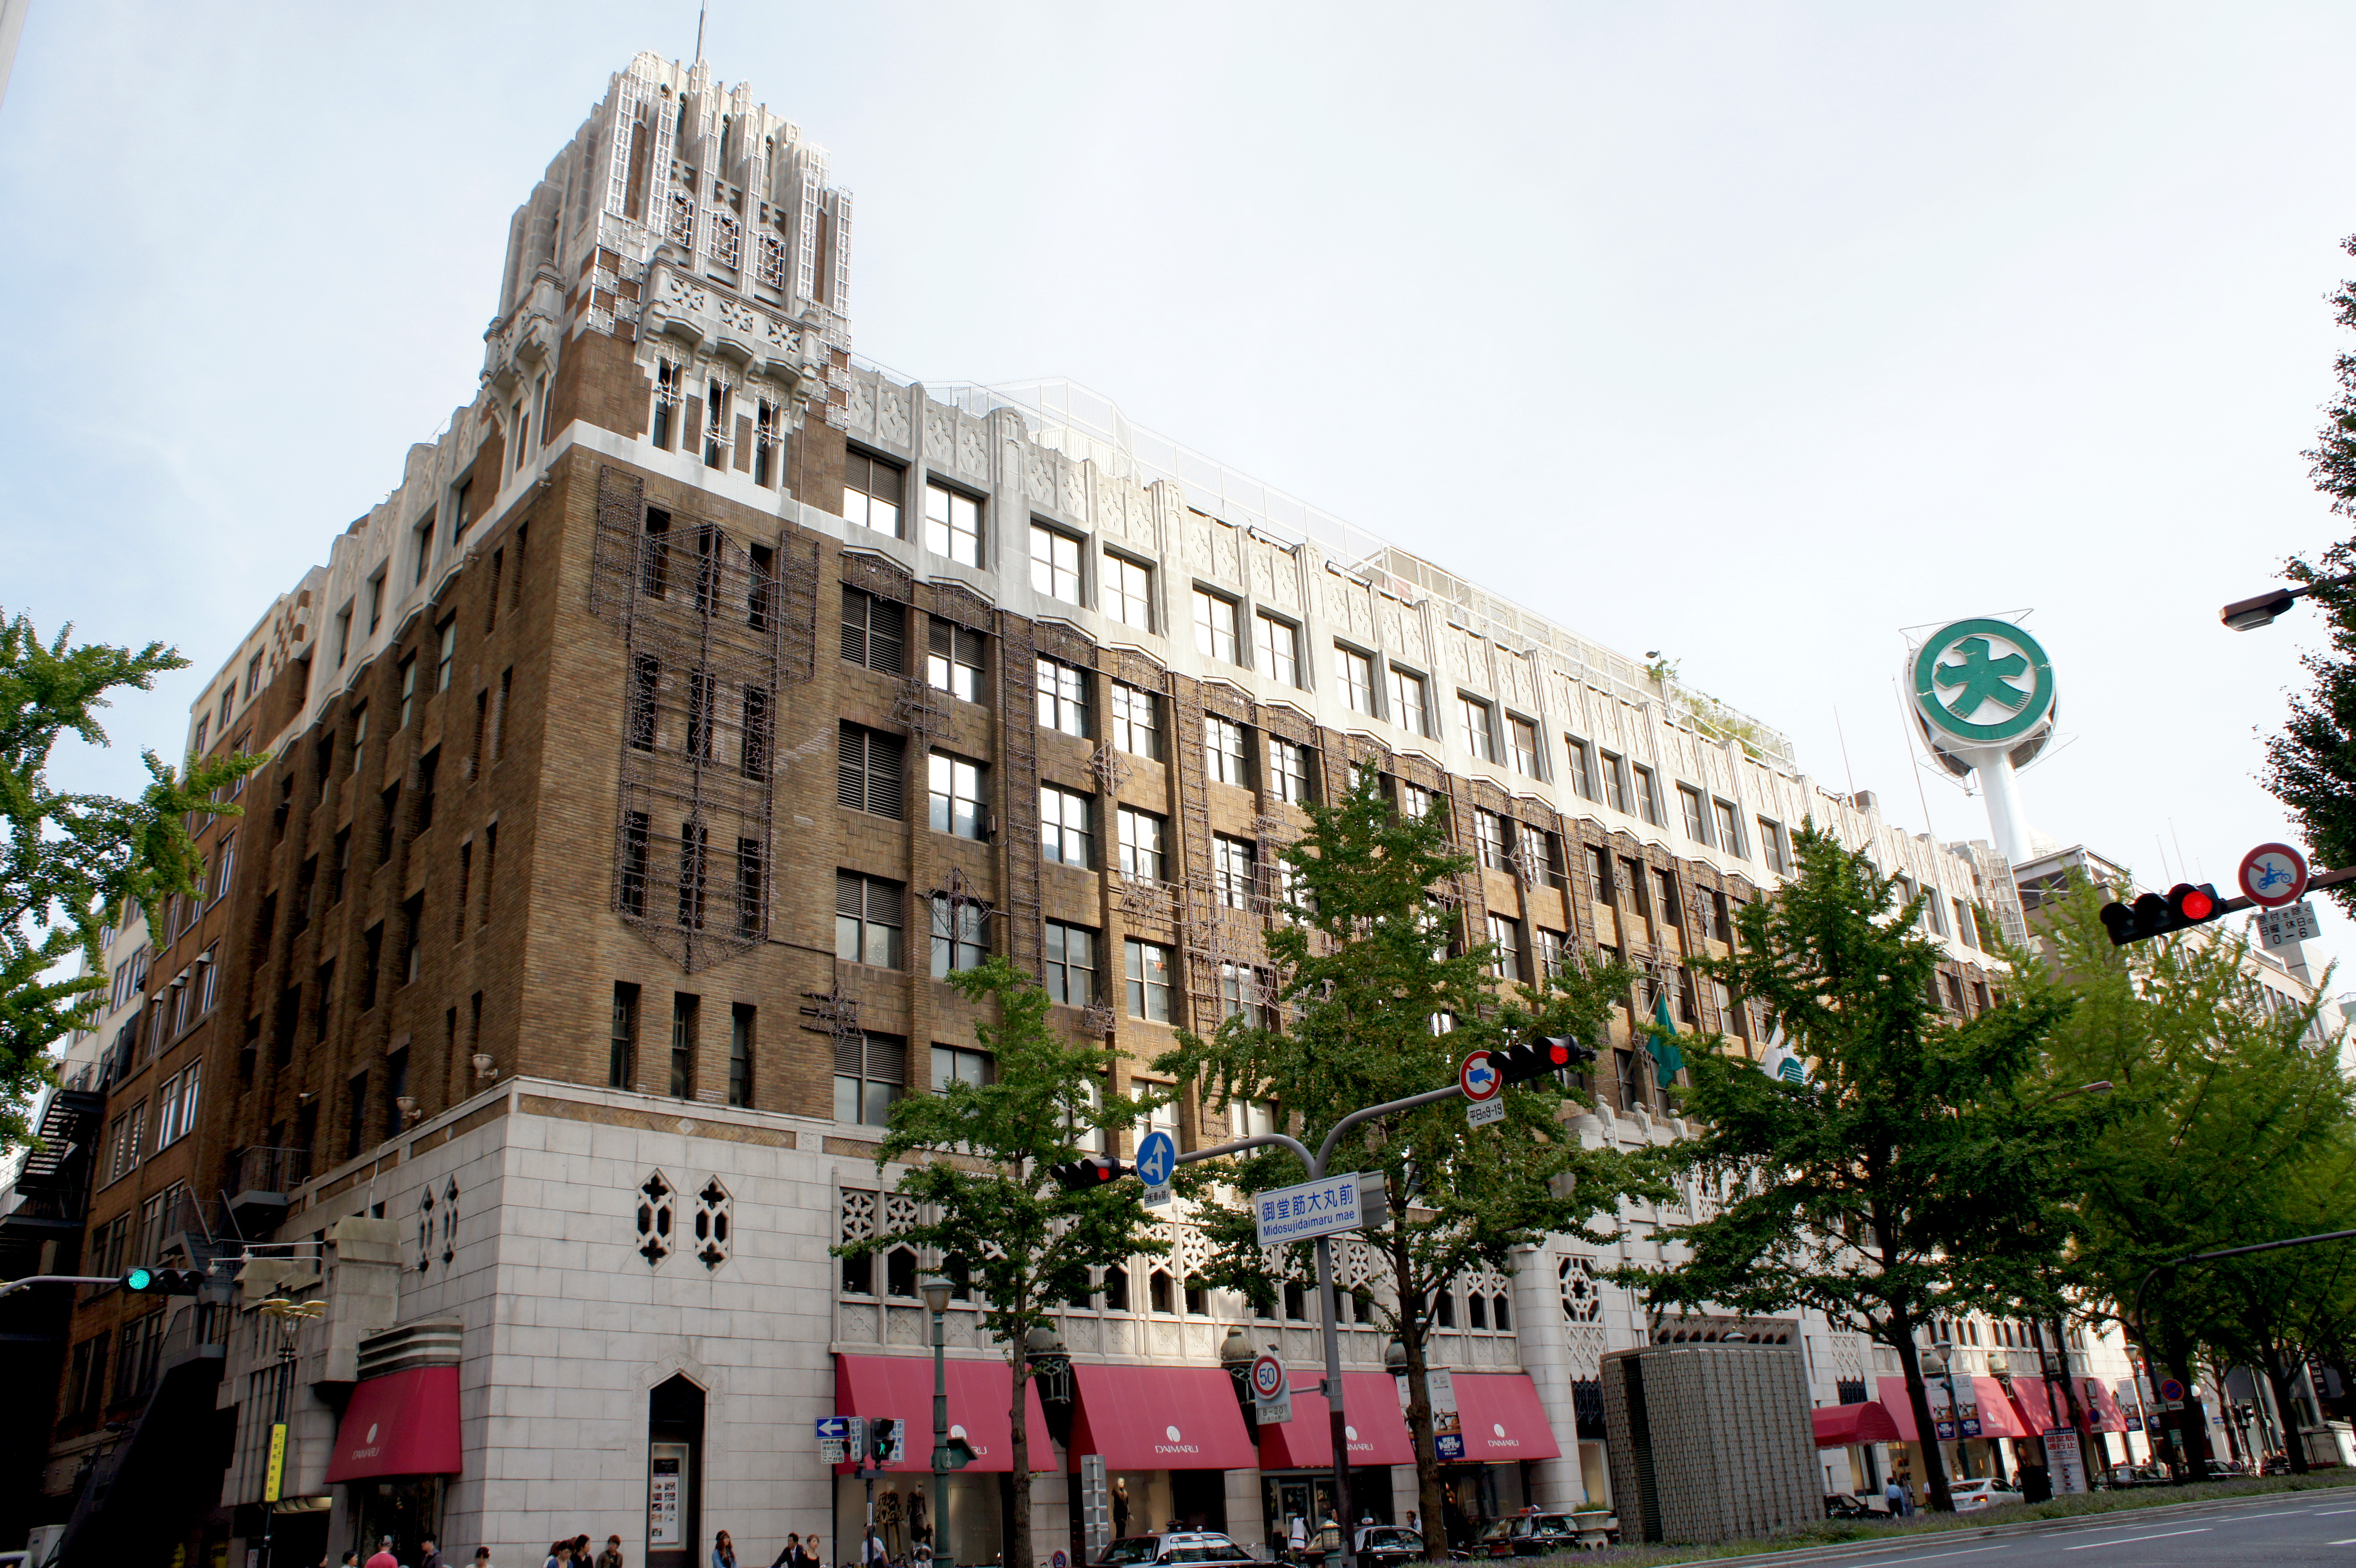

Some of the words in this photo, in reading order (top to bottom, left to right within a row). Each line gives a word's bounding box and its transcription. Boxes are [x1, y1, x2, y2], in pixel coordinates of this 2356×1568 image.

[2258, 906, 2311, 924] 原付を除く
[1145, 1190, 1170, 1204] 自転車を除く
[1262, 1183, 1353, 1223] 御堂筋大丸前
[1263, 1214, 1333, 1237] Midosujidaimaru
[1336, 1210, 1355, 1222] mae
[1259, 1367, 1275, 1385] 50
[2046, 1434, 2074, 1443] 御堂筋
[351, 1446, 380, 1460] DAIMARU
[1155, 1445, 1199, 1453] DAIMARU
[2047, 1441, 2076, 1451] 通行止
